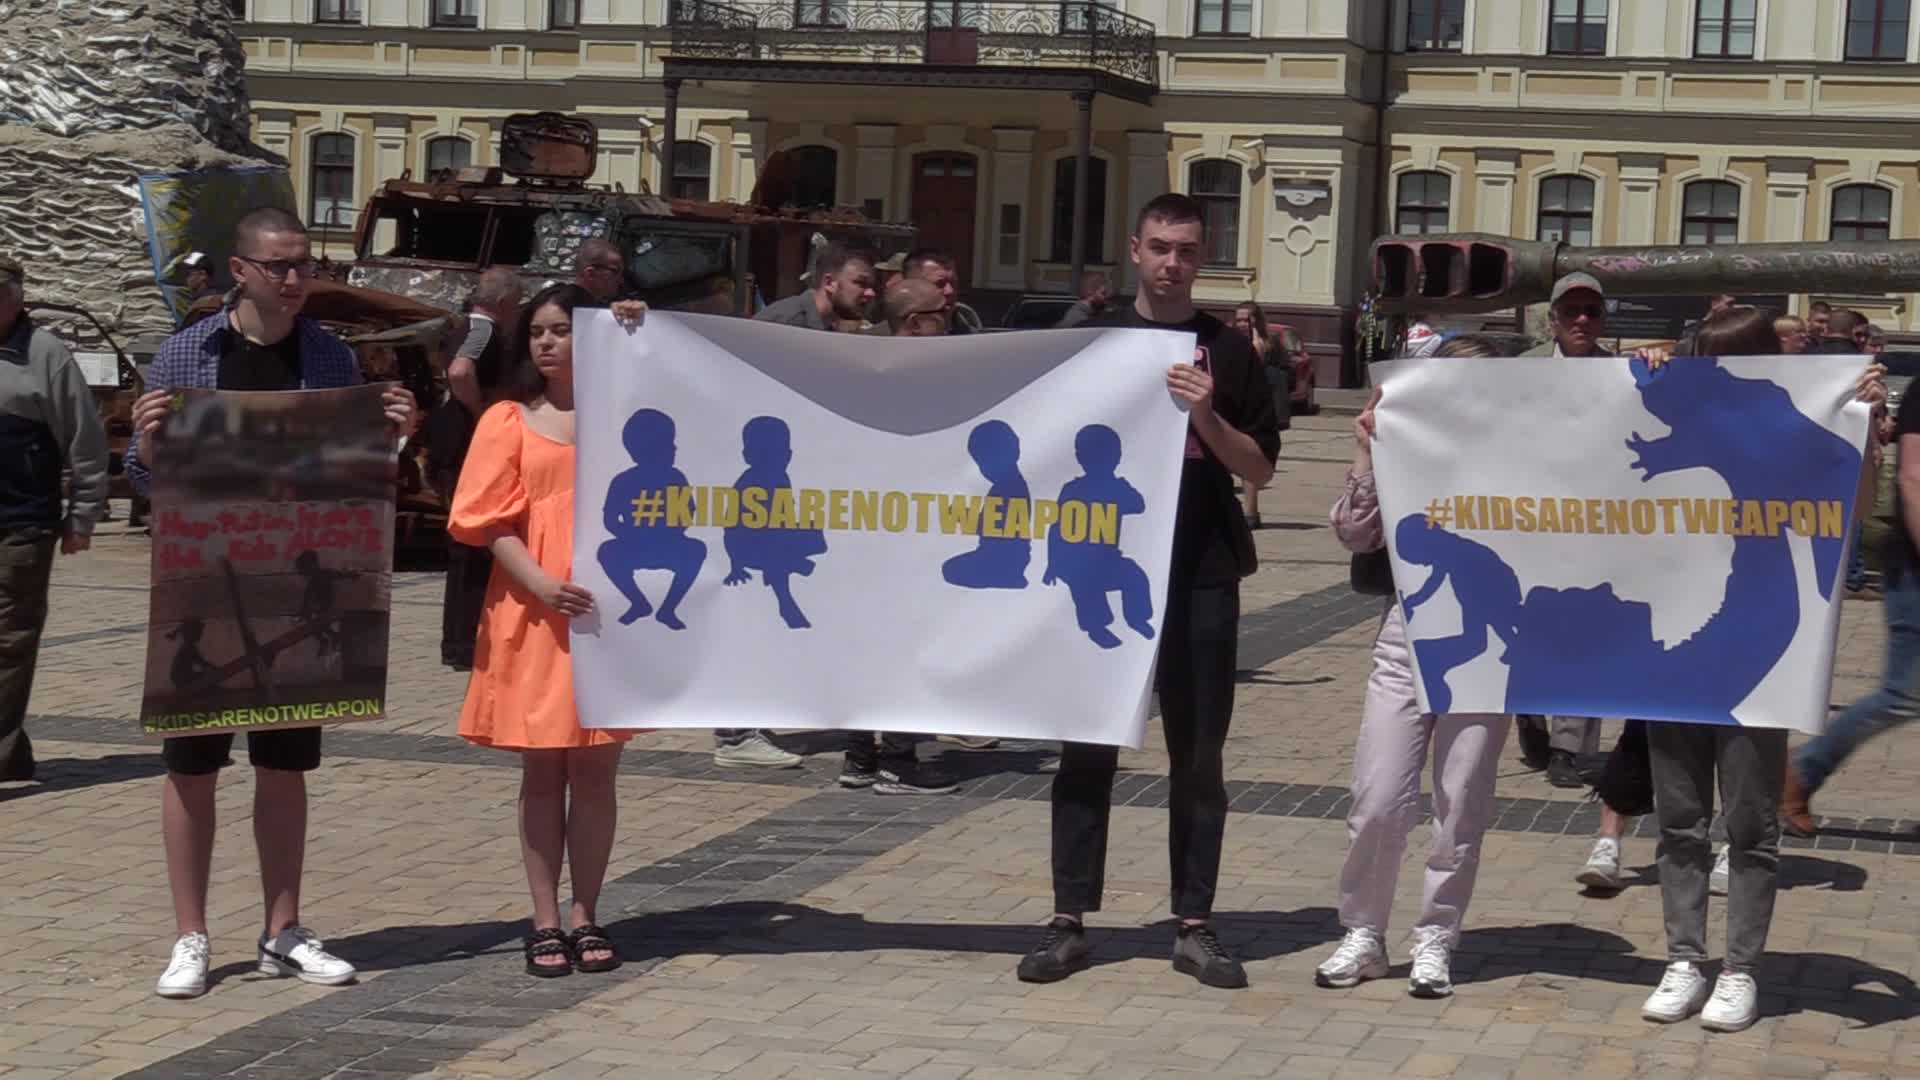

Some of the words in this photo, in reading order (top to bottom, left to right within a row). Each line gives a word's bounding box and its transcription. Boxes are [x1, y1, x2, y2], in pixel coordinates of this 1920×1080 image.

[631, 486, 1118, 545] #KIDSARENOTWEAPON
[1425, 495, 1842, 538] #KIDSARENOTWEAPON
[144, 699, 381, 733] #KIDSARENOTWEAPON
